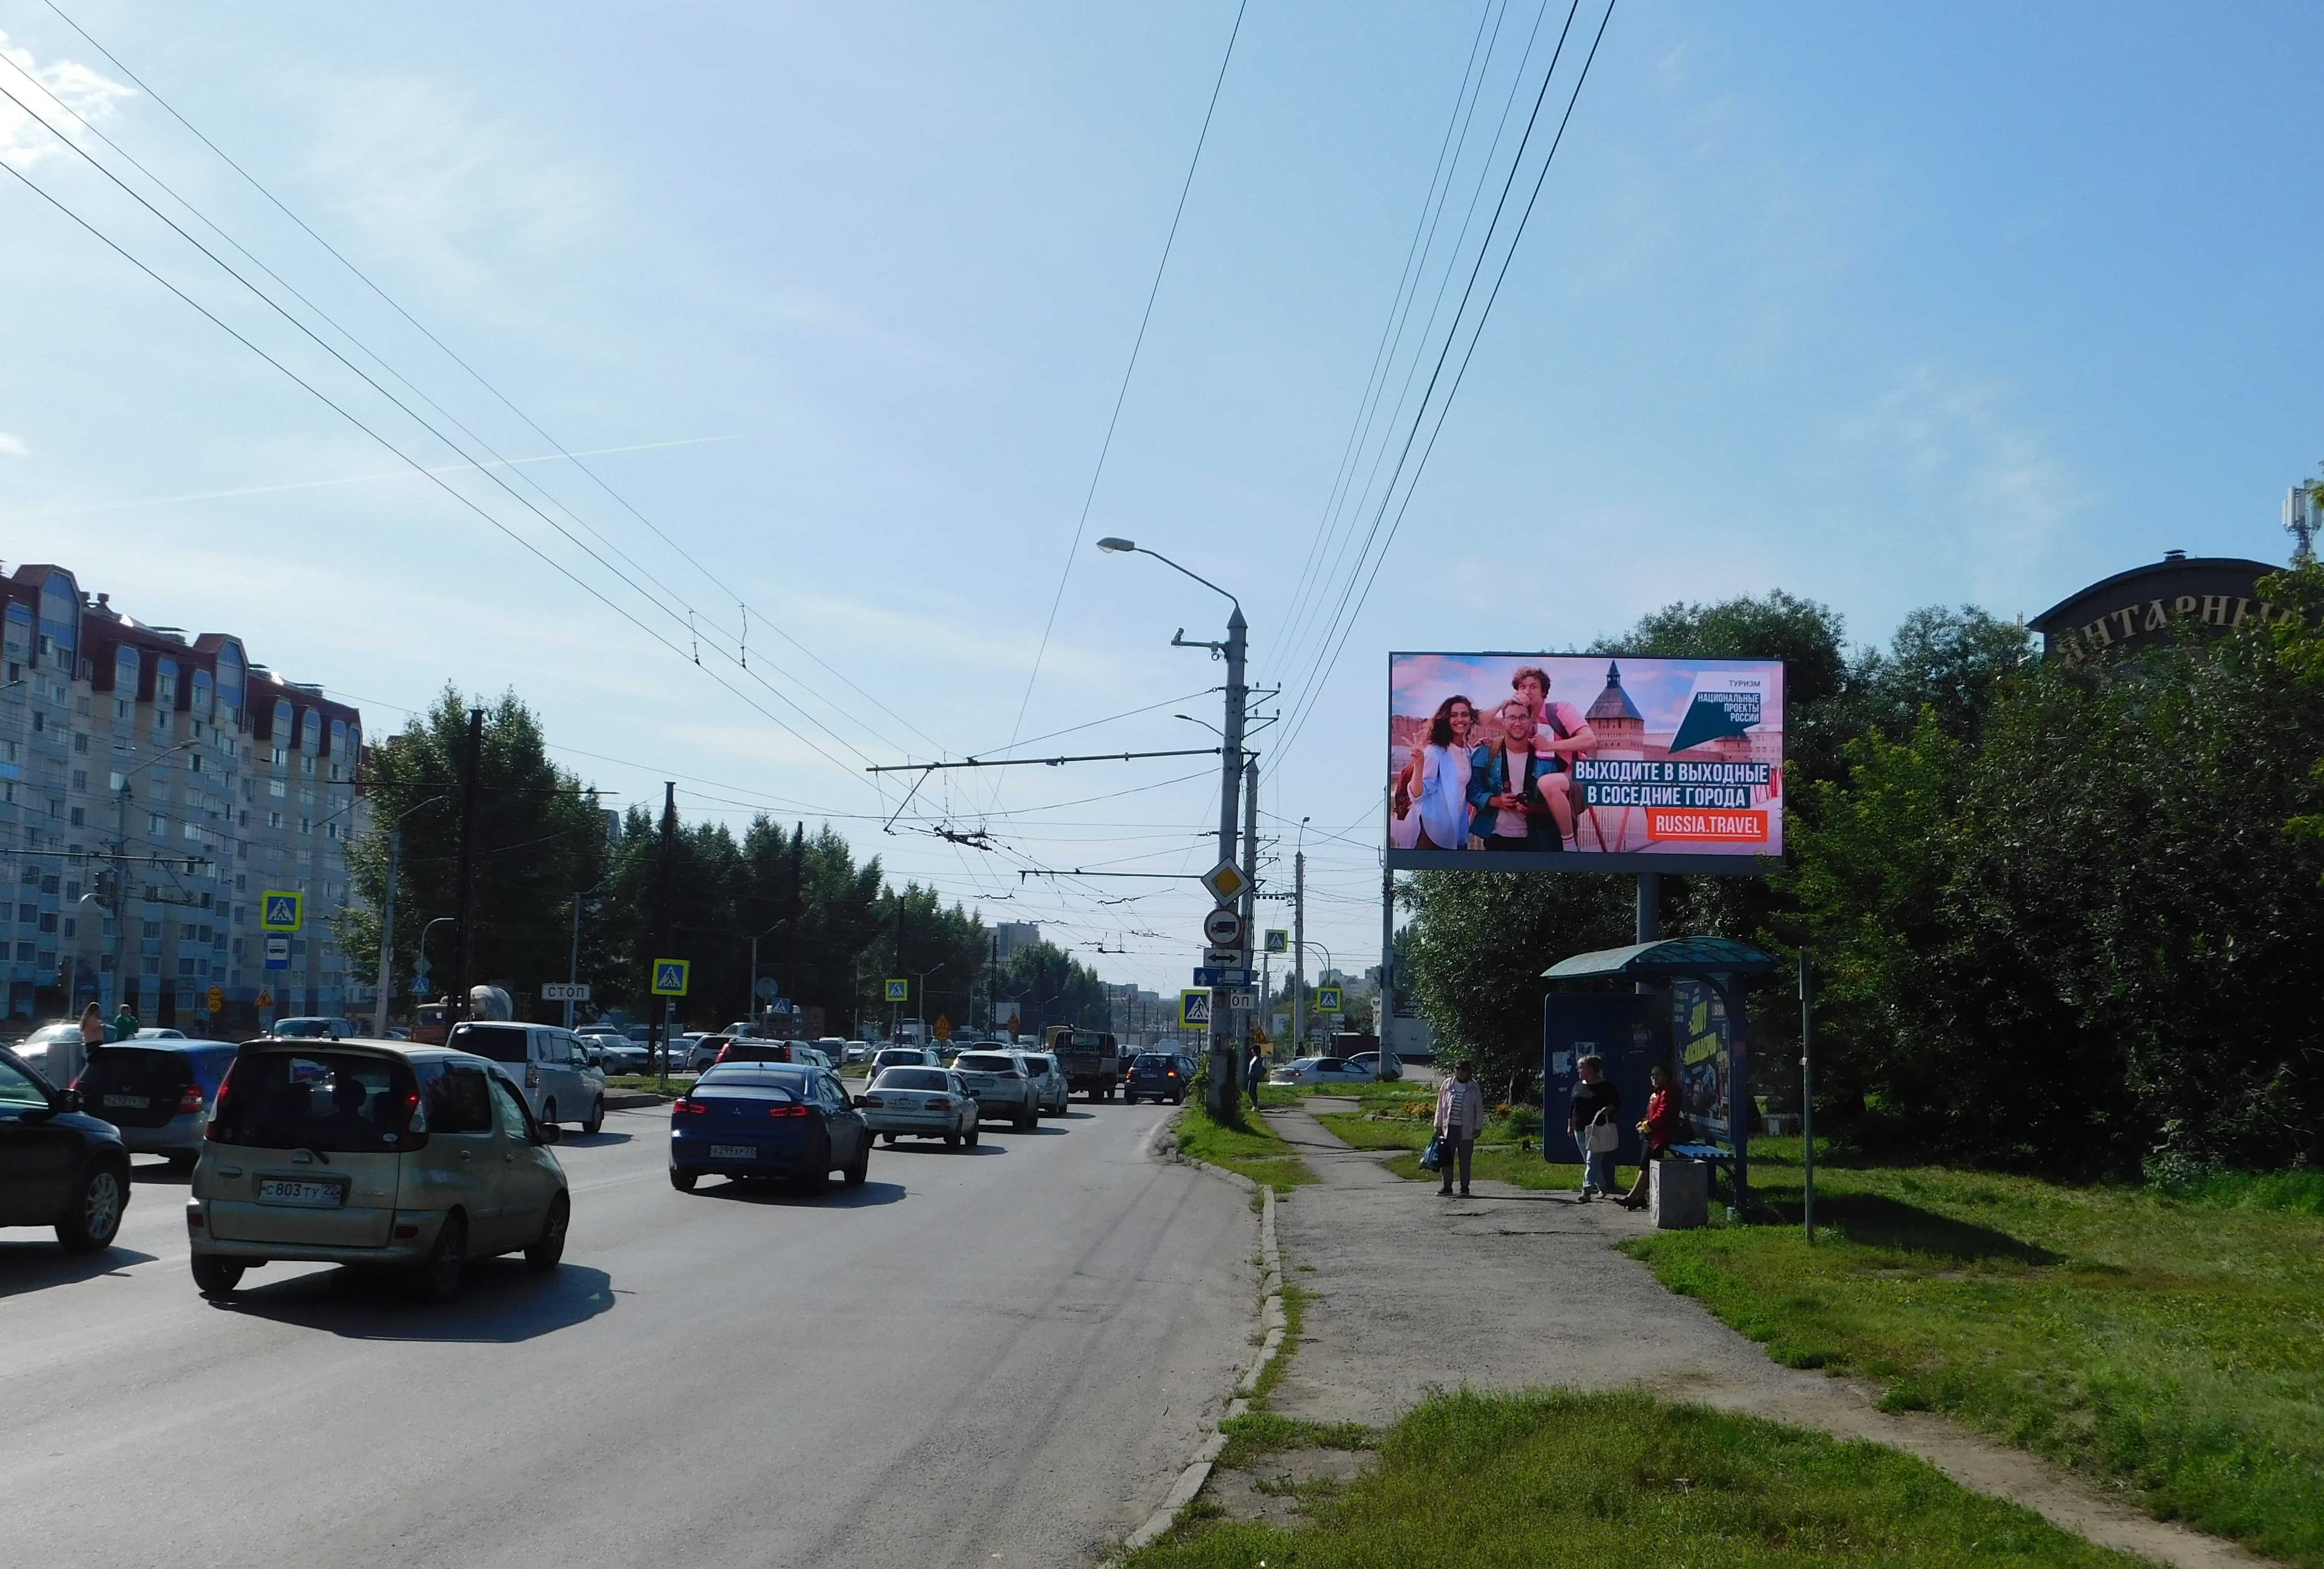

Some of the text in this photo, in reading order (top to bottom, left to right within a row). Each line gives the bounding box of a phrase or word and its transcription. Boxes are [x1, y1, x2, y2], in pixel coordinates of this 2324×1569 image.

[2055, 595, 2298, 668] ЯНТАРНЫ
[1698, 693, 1759, 703] НАЦИОНАЛЬНЫЕ
[1724, 703, 1759, 712] ПРОЕКТЫ
[1730, 713, 1759, 722] РОССИИ
[1575, 761, 1768, 784] ВЫХОДИТЕ В ВЫХОДНЫЕ
[1587, 786, 1745, 808] В СОСЕДНИЕ ГОРОДА
[1656, 815, 1761, 833] RUSSIA.TRAVEL
[548, 987, 583, 997] СТОП
[1232, 996, 1249, 1007] ОП
